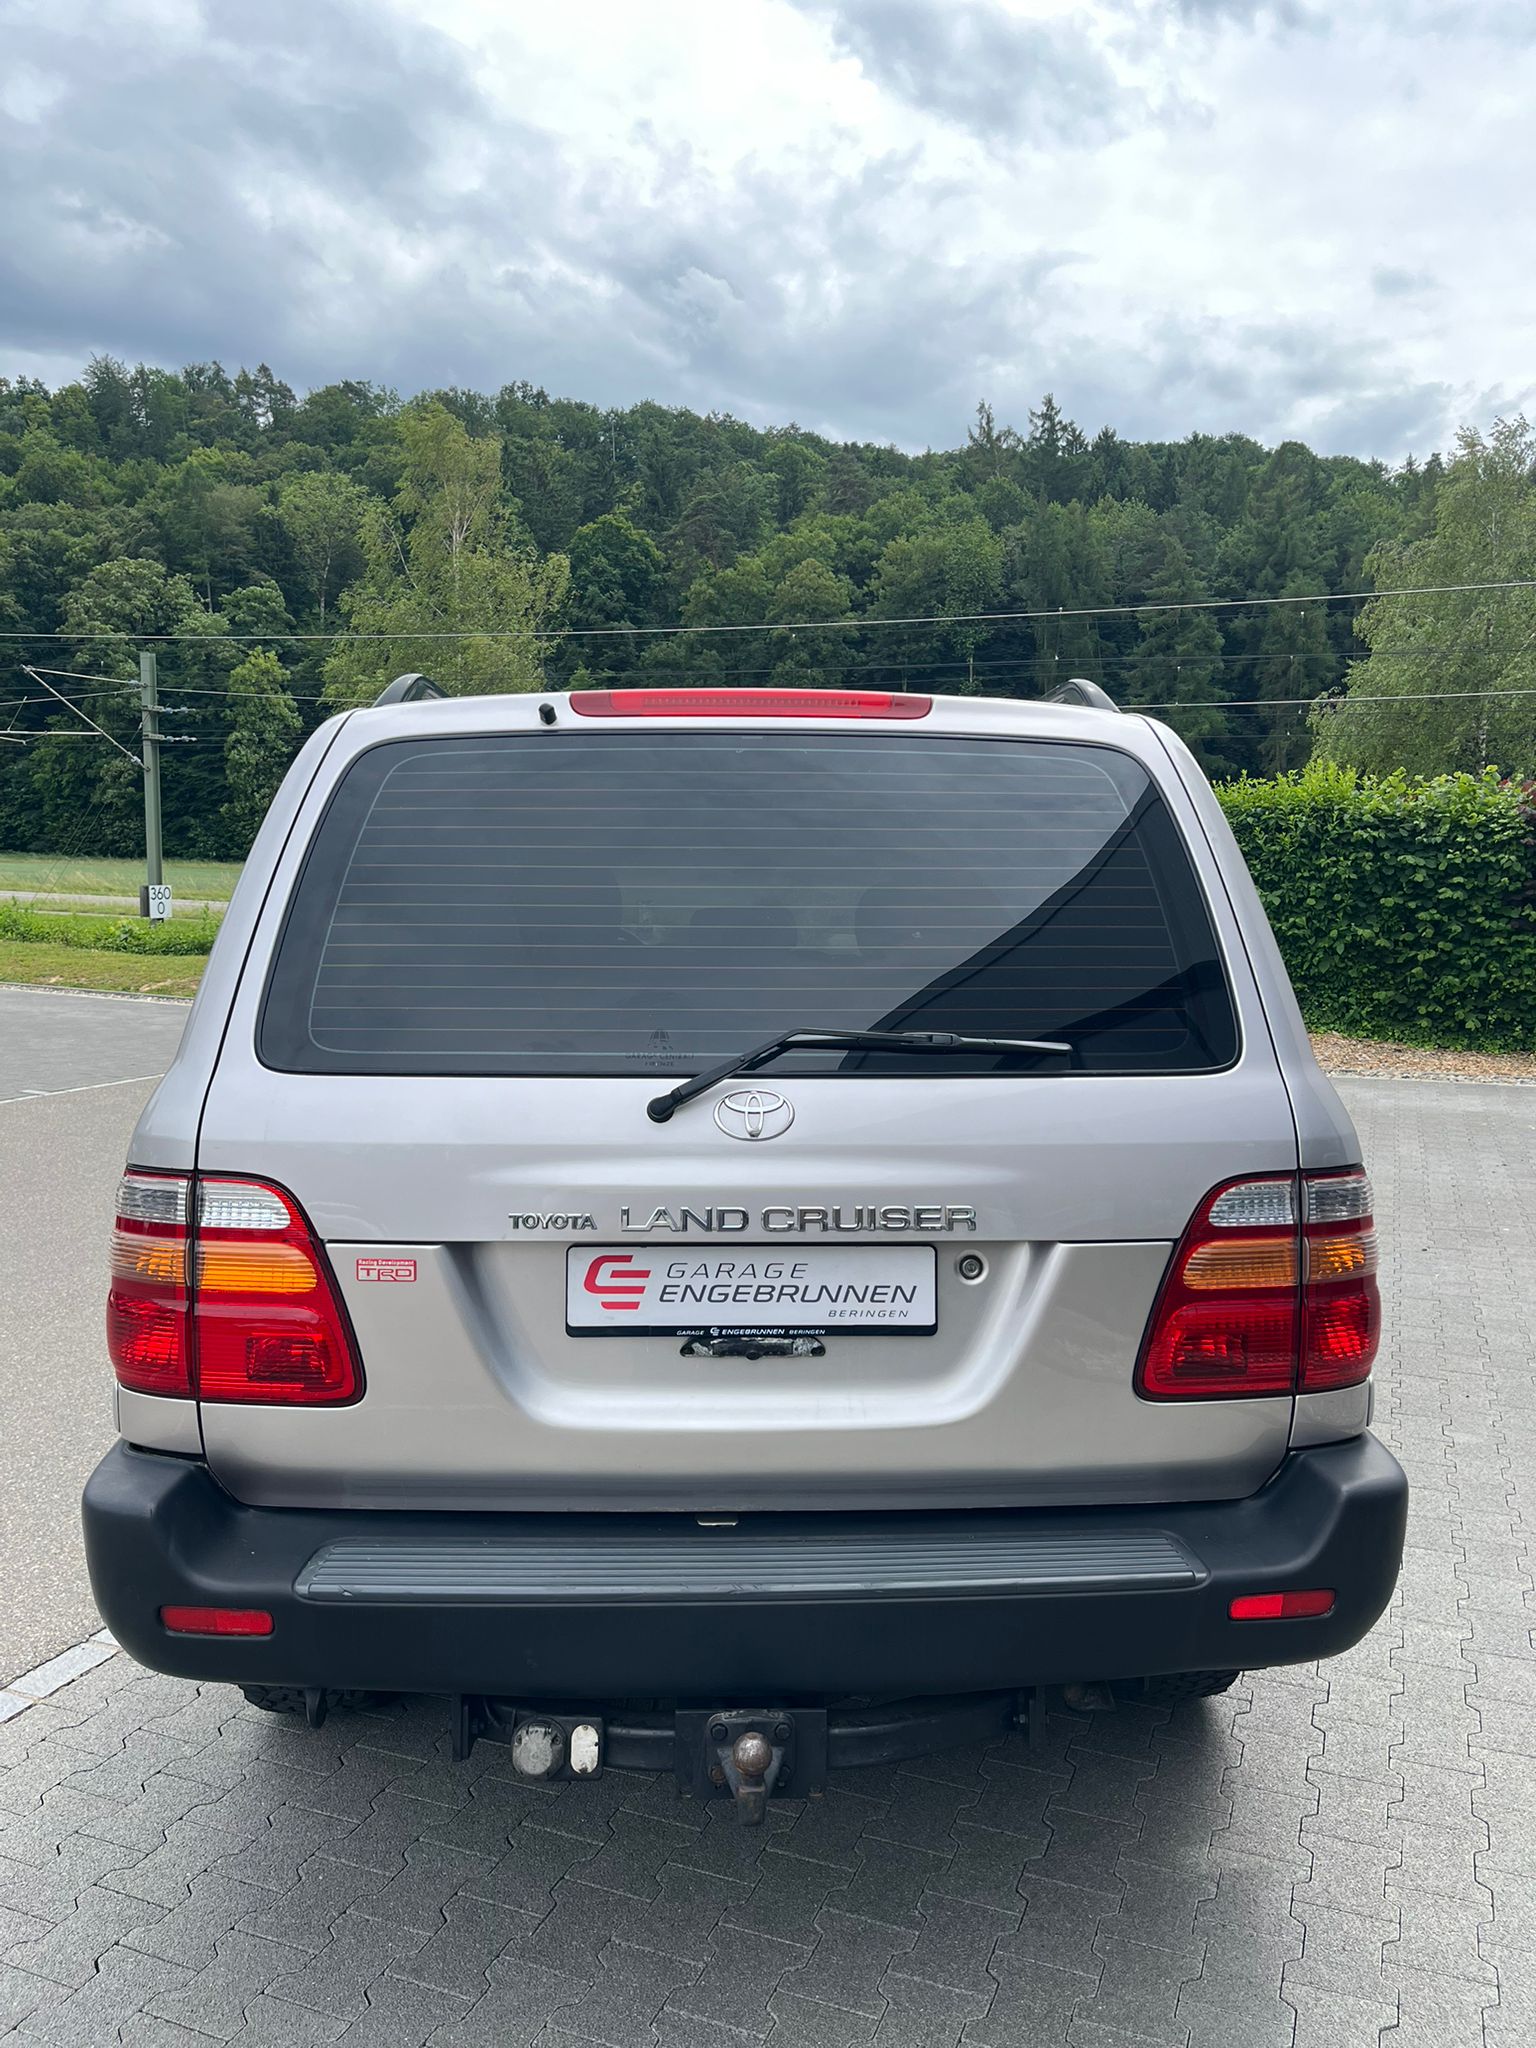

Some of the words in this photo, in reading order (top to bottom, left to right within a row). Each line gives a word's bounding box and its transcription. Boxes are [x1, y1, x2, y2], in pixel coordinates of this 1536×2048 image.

[150, 886, 171, 900] 360
[157, 901, 165, 914] 0
[508, 1212, 598, 1231] TOYOTA
[620, 1206, 750, 1232] LAND
[761, 1205, 977, 1232] CRUISER
[360, 1267, 412, 1280] TRD
[666, 1262, 809, 1279] GARAGE
[658, 1284, 918, 1304] ENGEBRUNNEN
[827, 1309, 909, 1318] BERINGEN
